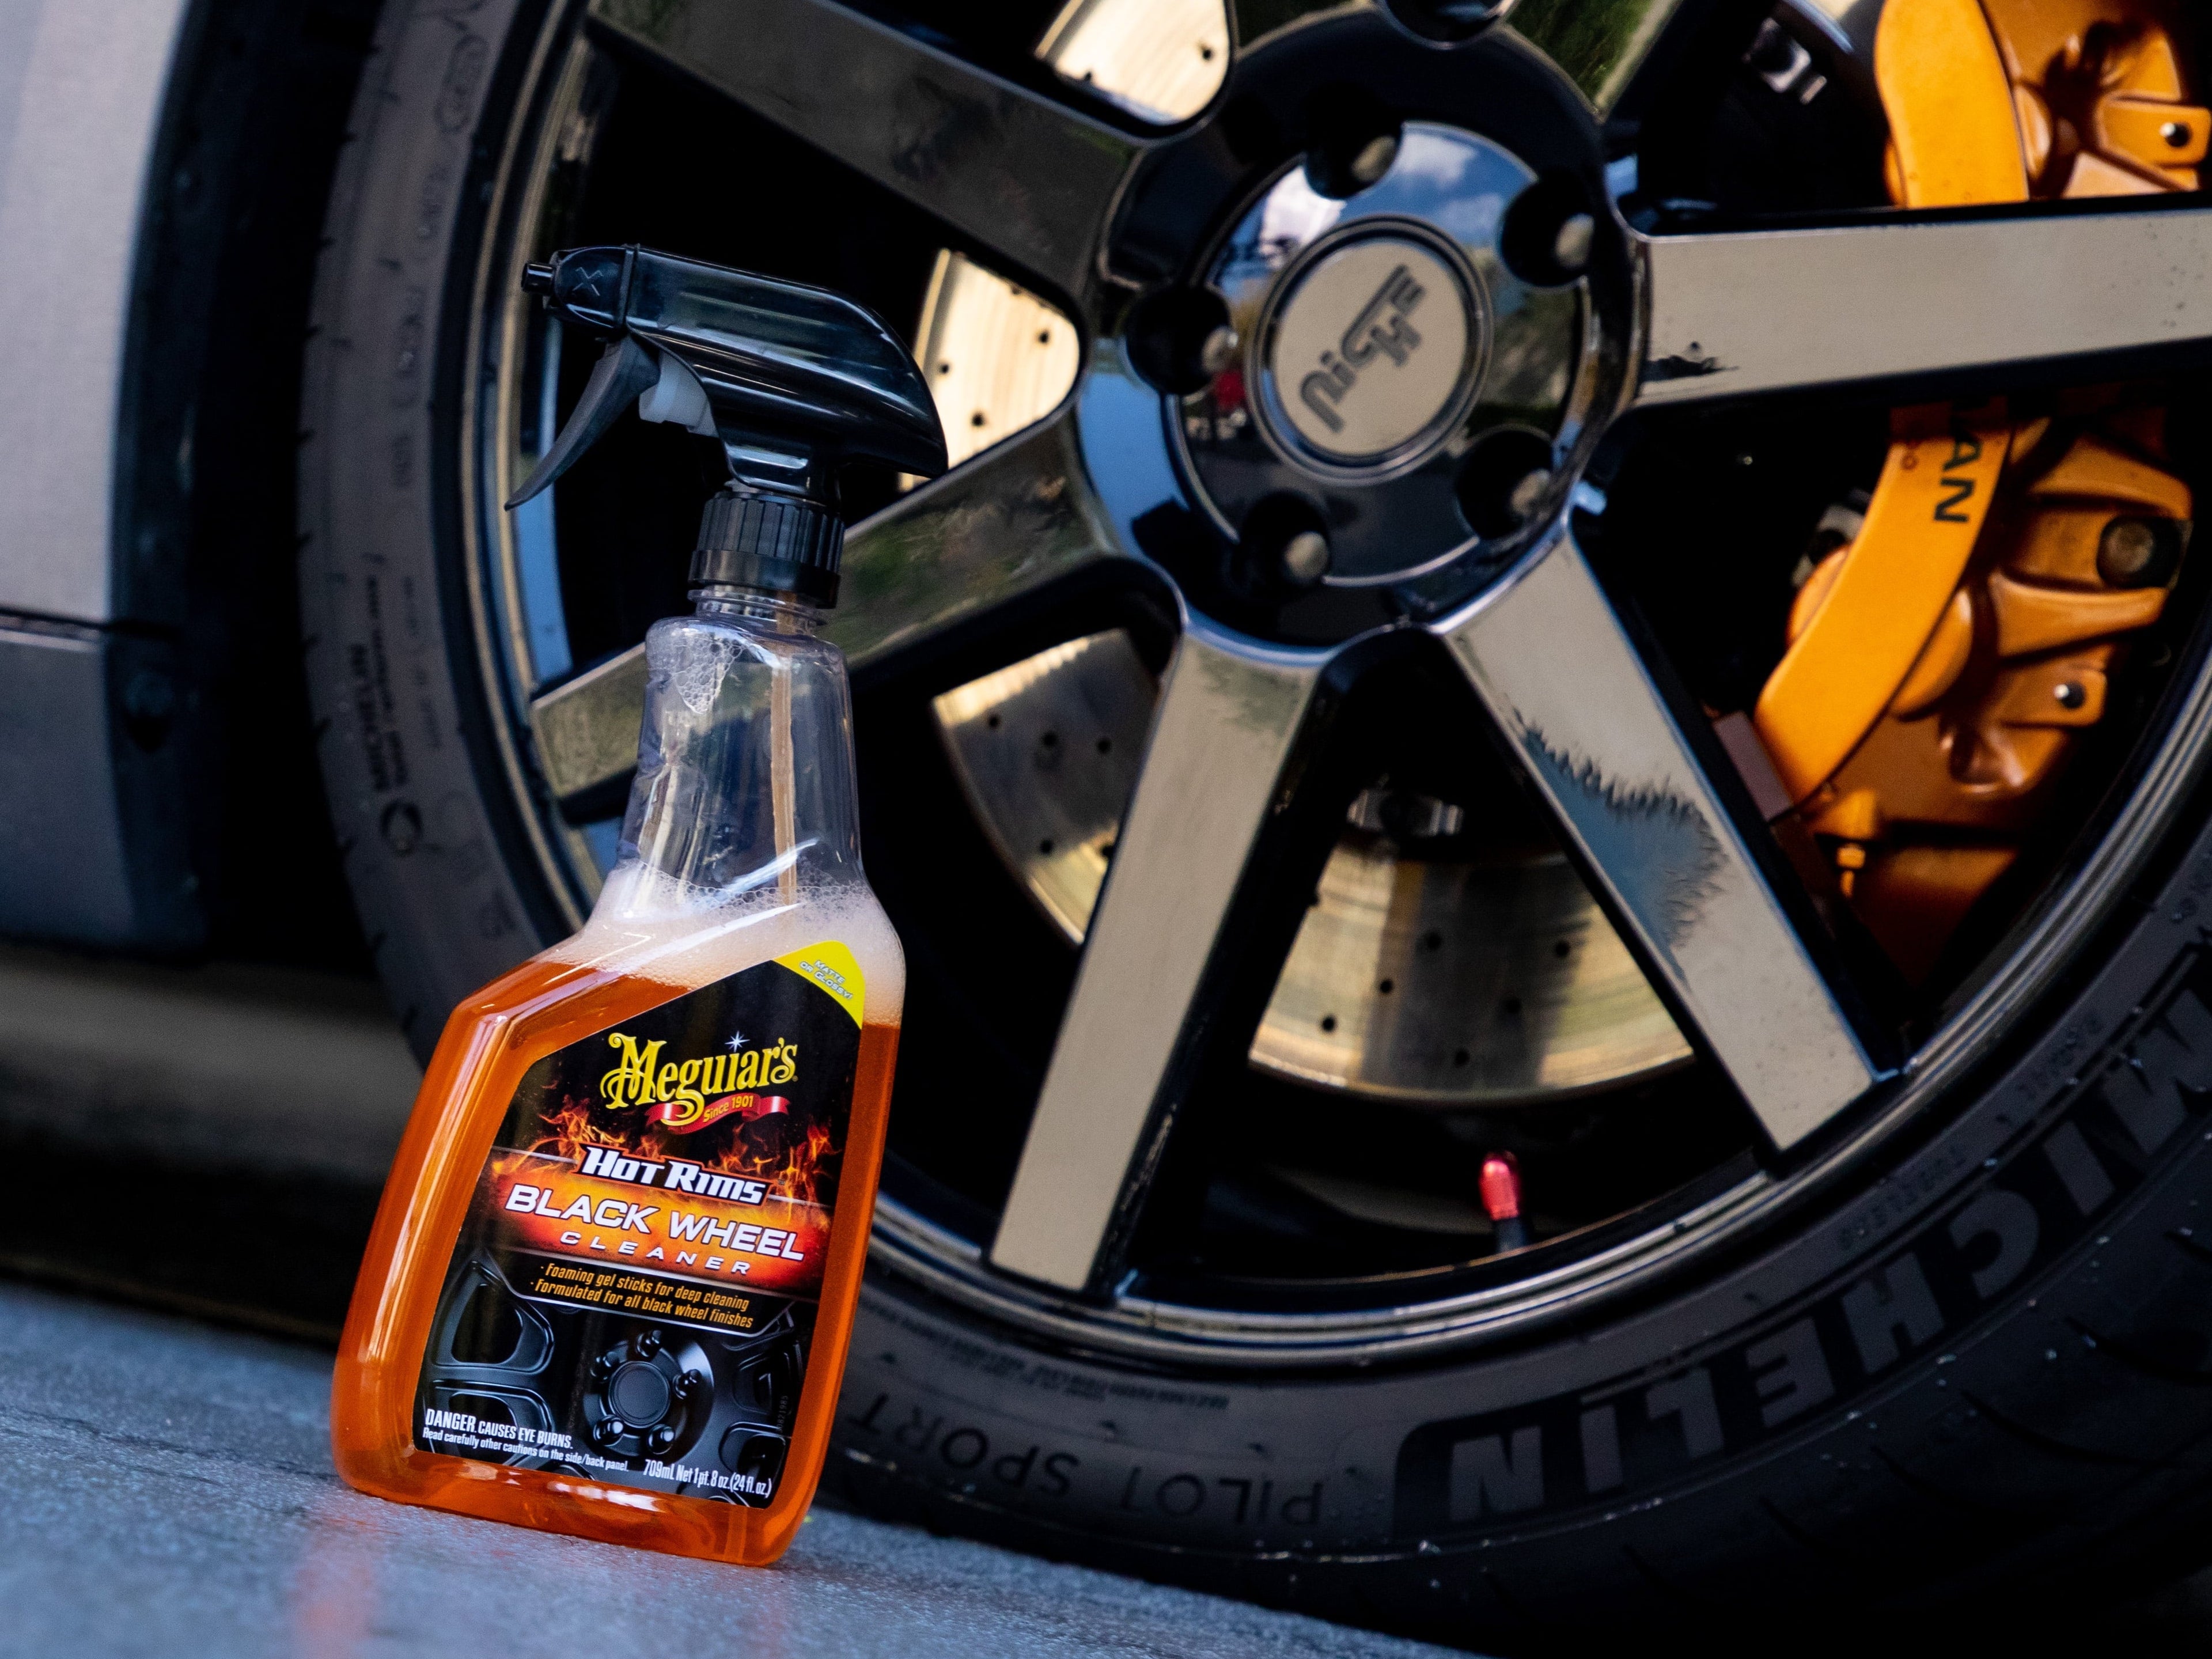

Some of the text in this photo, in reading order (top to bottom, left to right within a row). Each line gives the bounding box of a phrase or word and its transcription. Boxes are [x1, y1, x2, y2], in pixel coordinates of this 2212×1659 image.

[800, 961, 813, 973] OR
[815, 960, 846, 984] MATTE
[600, 1032, 798, 1126] Meguiar's
[703, 1094, 753, 1123] Since 1901
[582, 1146, 665, 1184] HOT
[505, 1184, 805, 1261] BLACK WHEEL
[559, 1230, 751, 1275] CLEANER
[1448, 988, 2211, 1522] MICHELIN
[535, 1278, 753, 1328] Formulated for all black wheel finishes
[545, 1263, 749, 1313] Foaming gel sticks for deep cleaning
[422, 1427, 443, 1441] Read
[444, 1431, 479, 1449] carefully
[480, 1438, 502, 1450] other
[502, 1442, 538, 1457] cautions
[538, 1449, 550, 1459] on
[551, 1448, 565, 1461] the
[605, 1460, 630, 1472] panel.
[478, 1421, 517, 1440] CAUSES
[518, 1429, 536, 1444] EYE
[537, 1431, 574, 1449] BURNS.
[642, 1459, 675, 1481] 709mL
[675, 1464, 693, 1483] Net
[847, 1392, 1324, 1525] PILOT SPORT
